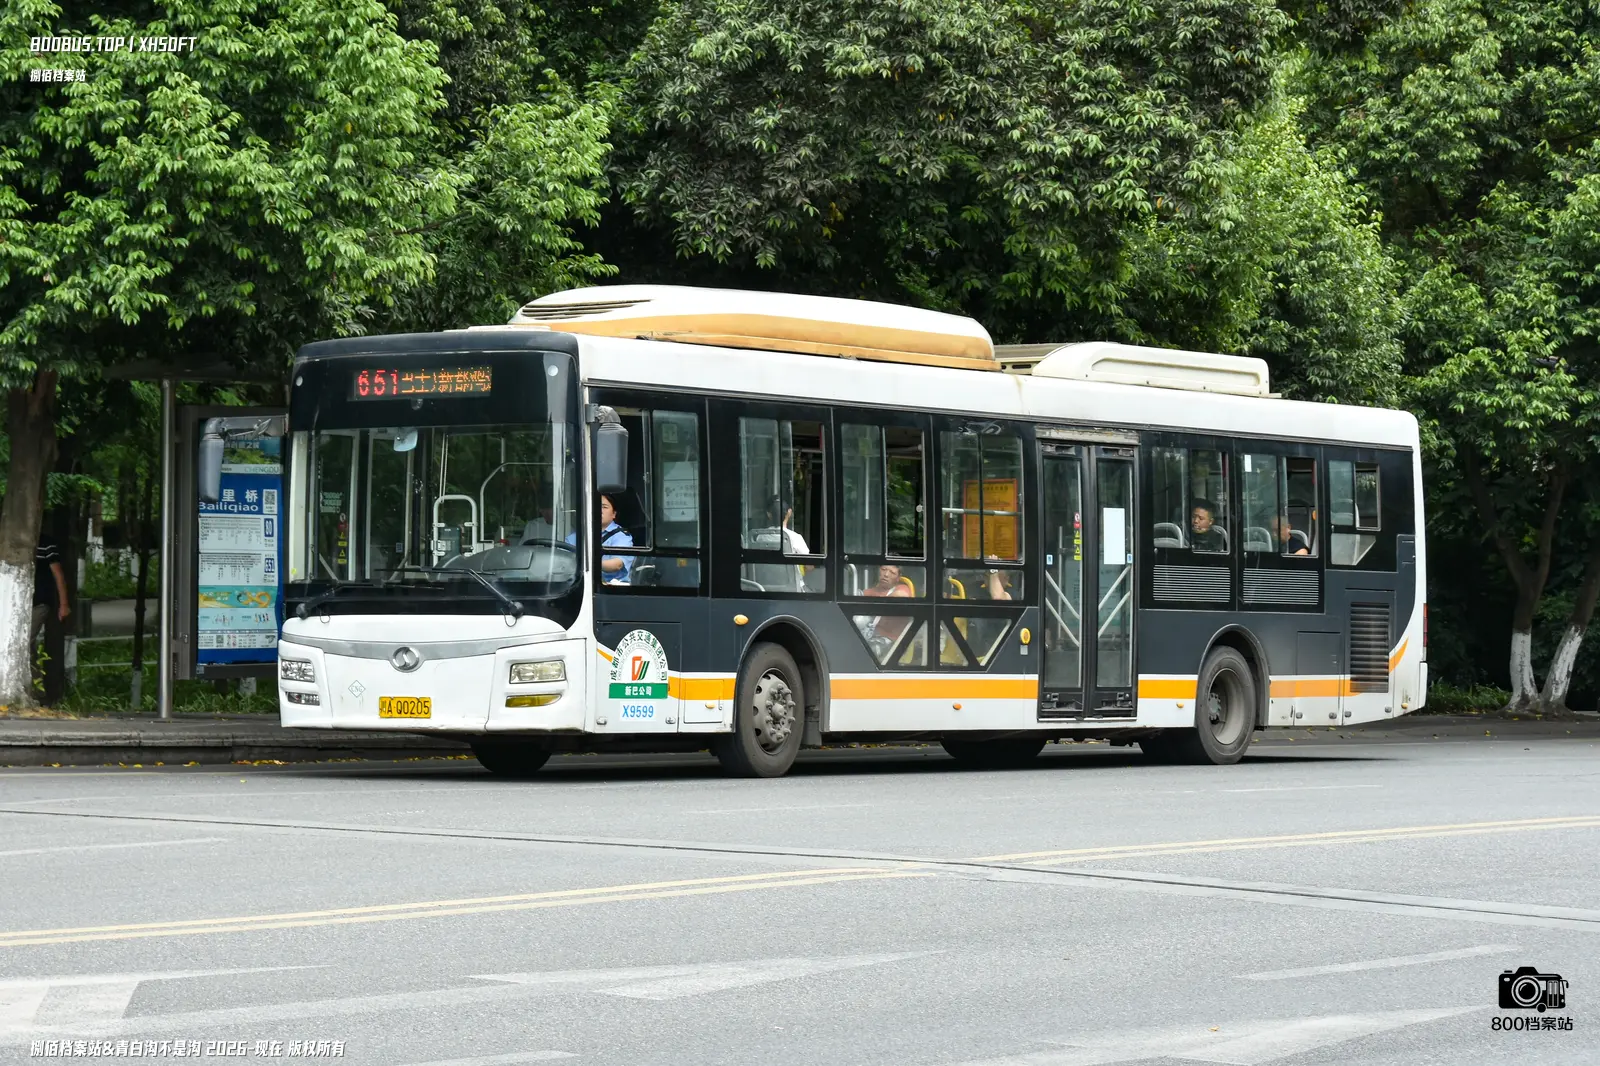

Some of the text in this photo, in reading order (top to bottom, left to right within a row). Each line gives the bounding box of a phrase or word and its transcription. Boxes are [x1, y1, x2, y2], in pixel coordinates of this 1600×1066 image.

[357, 370, 398, 396] 651
[610, 630, 668, 681] 成都市公共交通集团公司
[625, 685, 652, 696] 新巴公司
[622, 704, 654, 718] X9599
